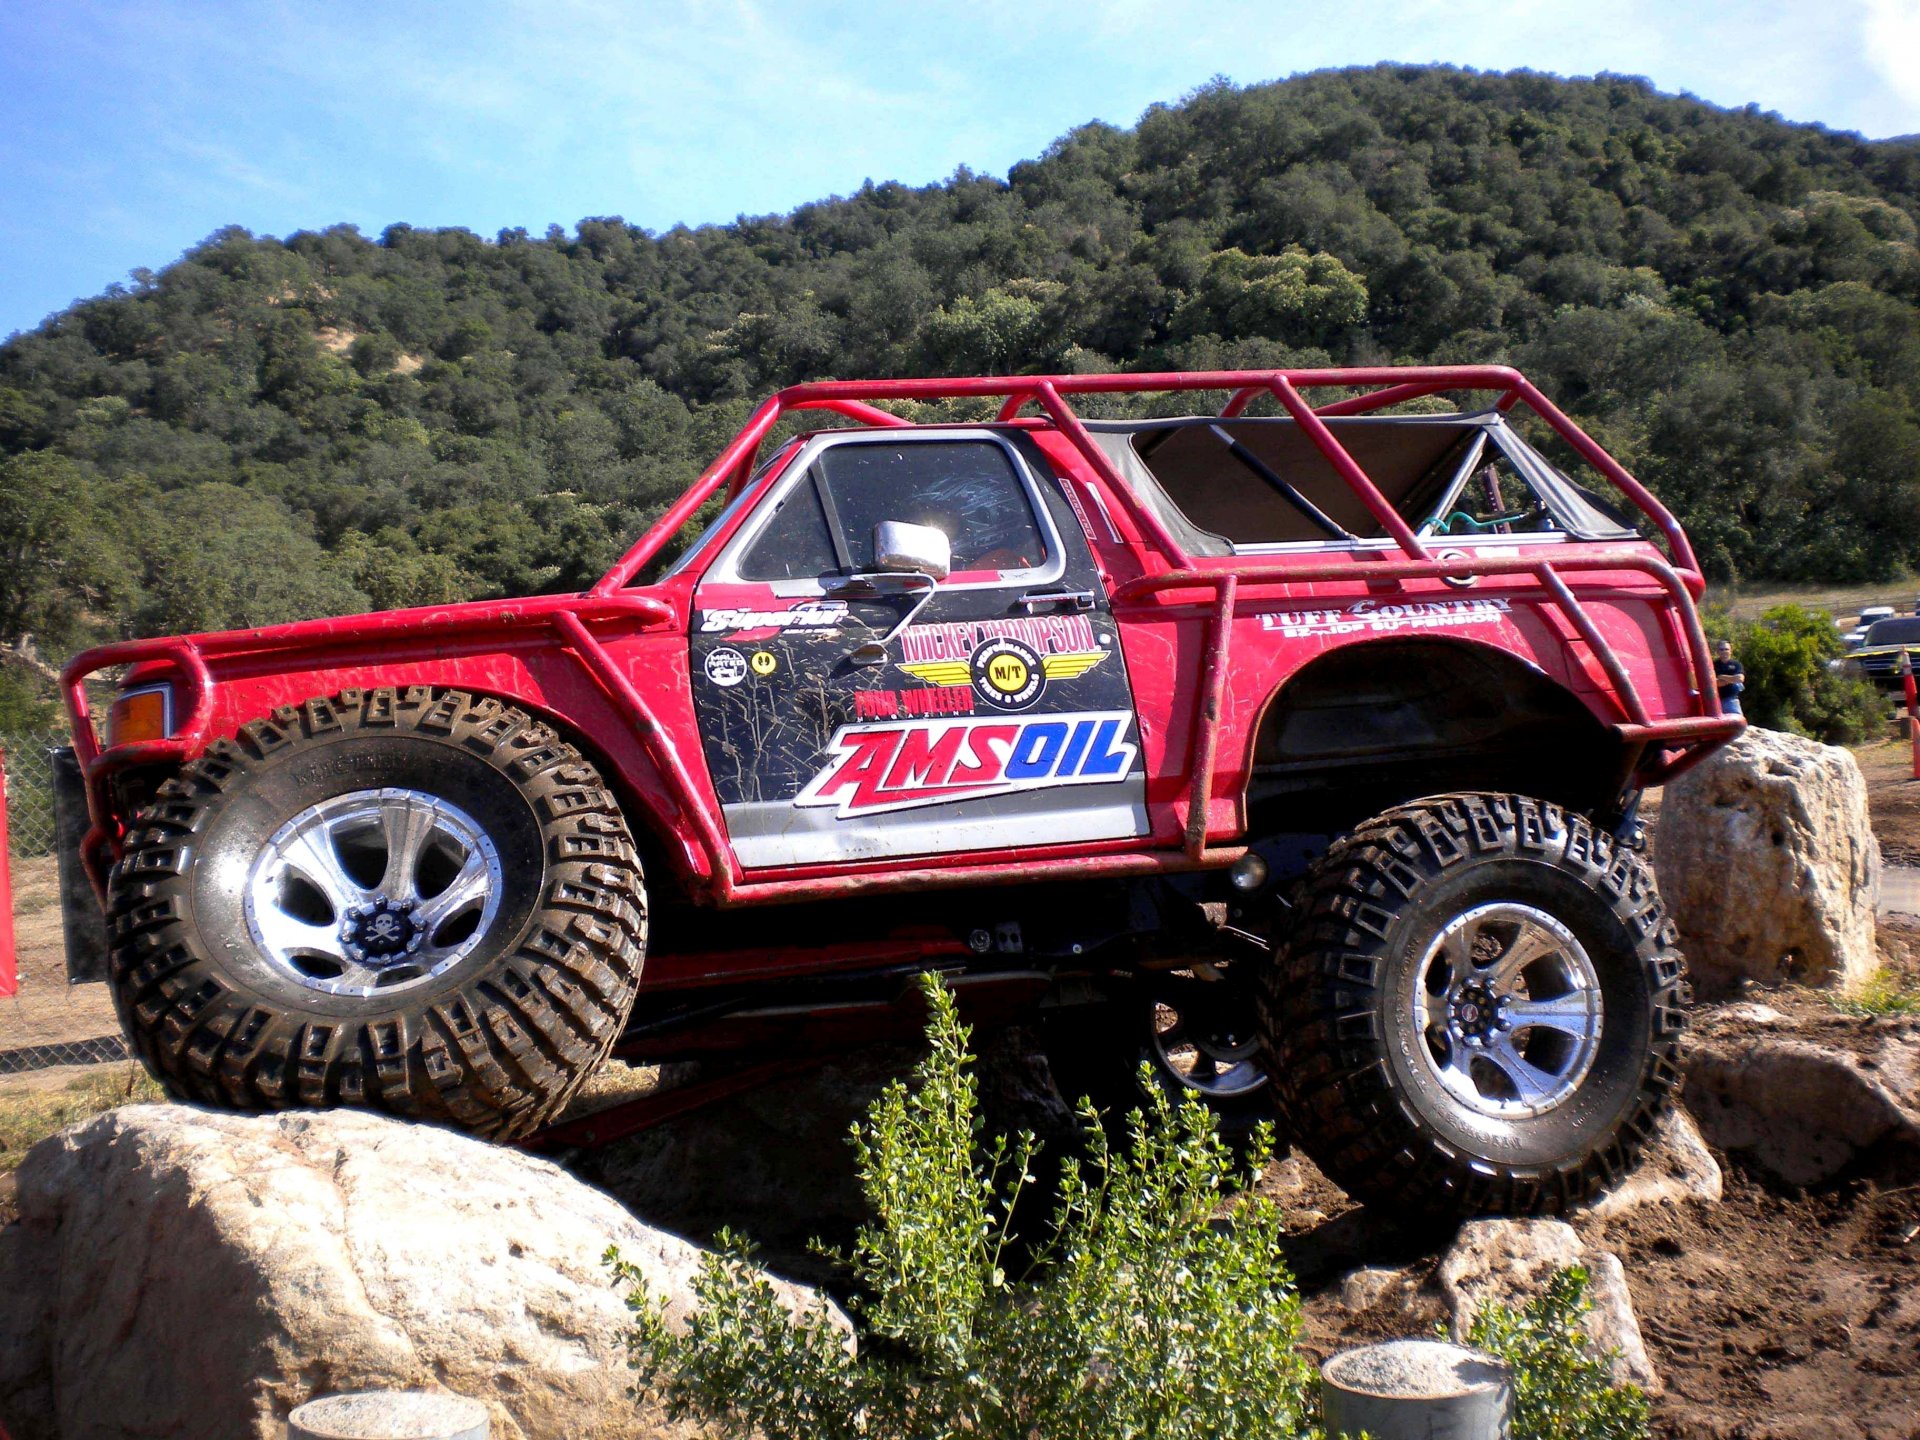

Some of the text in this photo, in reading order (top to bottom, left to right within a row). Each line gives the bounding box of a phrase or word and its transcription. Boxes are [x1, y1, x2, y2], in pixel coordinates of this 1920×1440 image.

[1256, 599, 1512, 627] TUFF COUNTRY
[994, 665, 1021, 681] M/T
[854, 685, 974, 717] FOUR WHEELER
[857, 709, 975, 723] MAGAZINE
[815, 720, 1129, 808] AMSOIL
